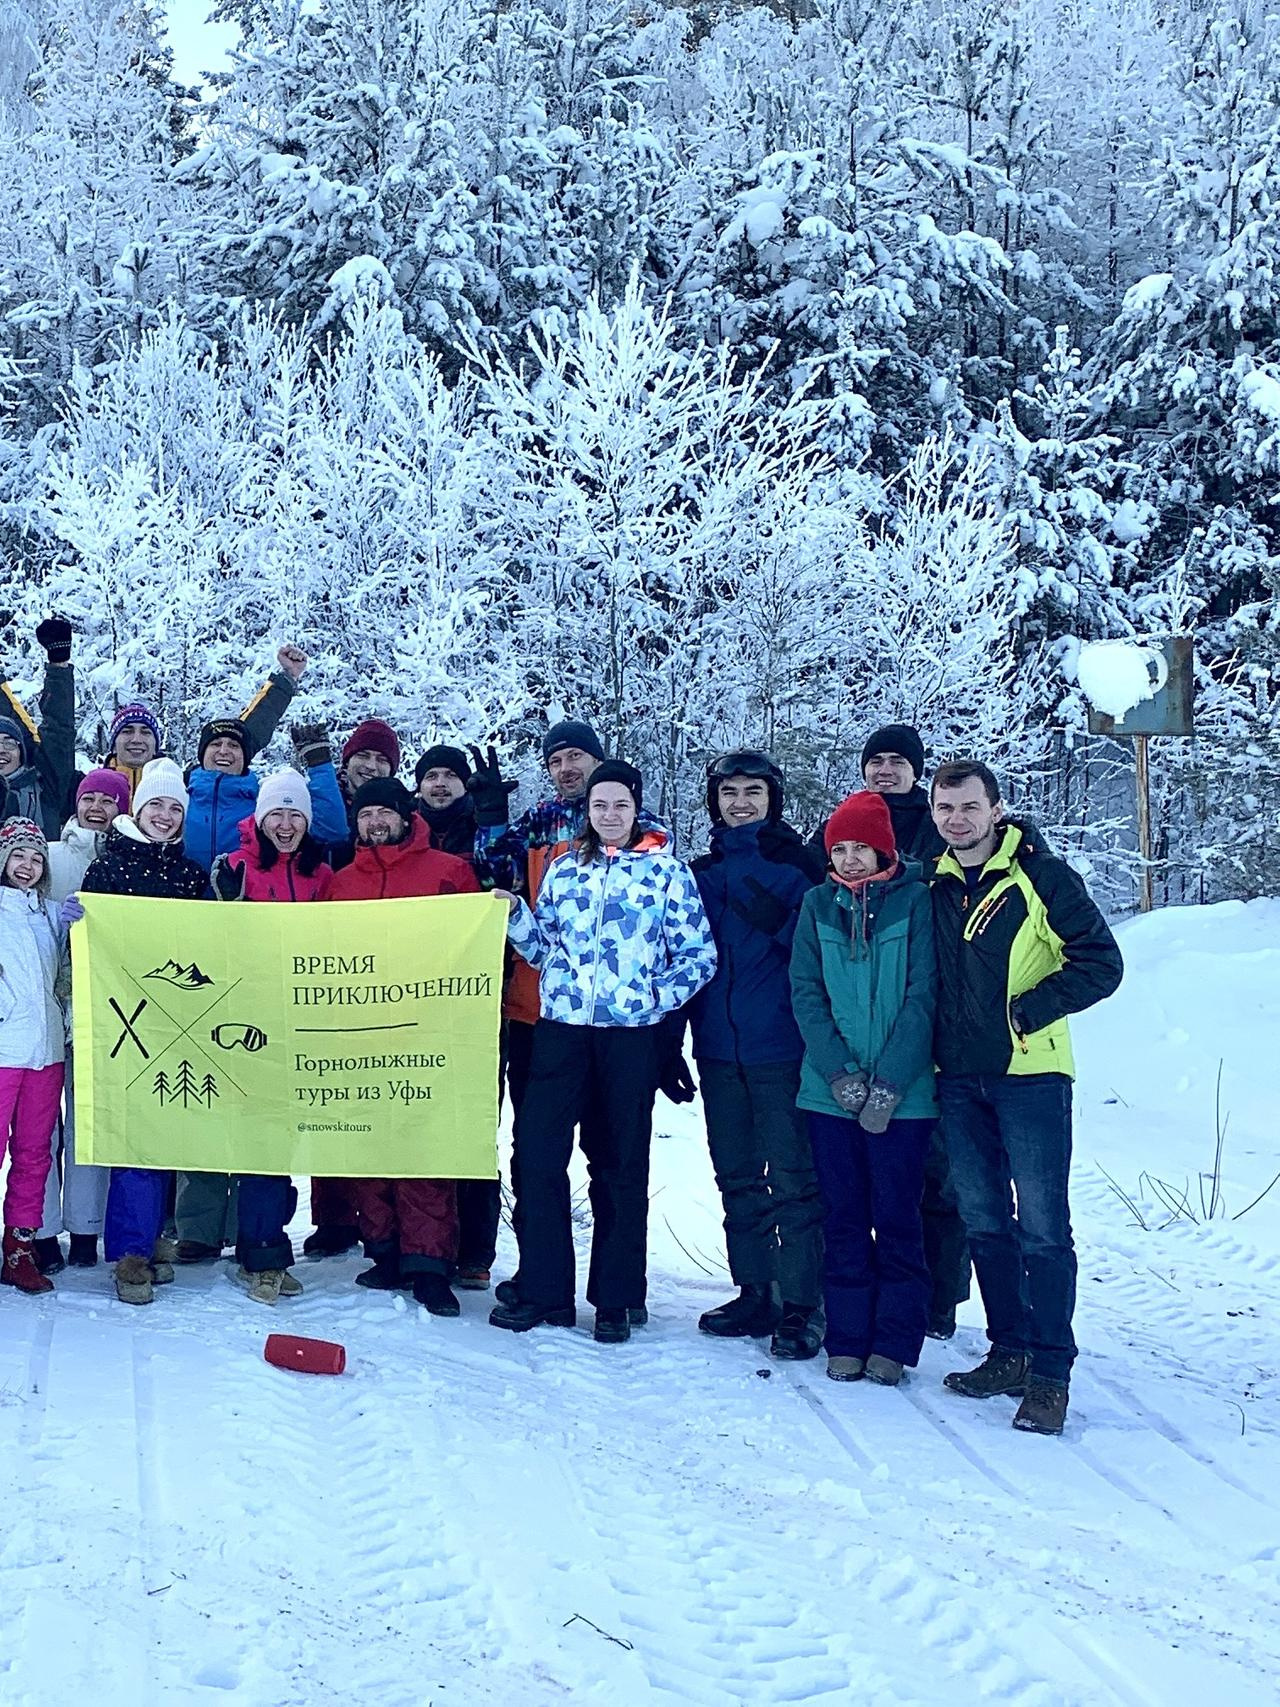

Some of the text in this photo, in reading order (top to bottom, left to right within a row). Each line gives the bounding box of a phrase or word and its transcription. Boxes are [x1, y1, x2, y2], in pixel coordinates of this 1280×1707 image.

[292, 955, 376, 975] ВРЕМЯ
[292, 972, 492, 1005] ПРИКЛЮЧЕНИЙ
[294, 1053, 446, 1077] Горнолыжные
[295, 1080, 432, 1106] туры из Уфы
[297, 1121, 372, 1132] @snowskitours
